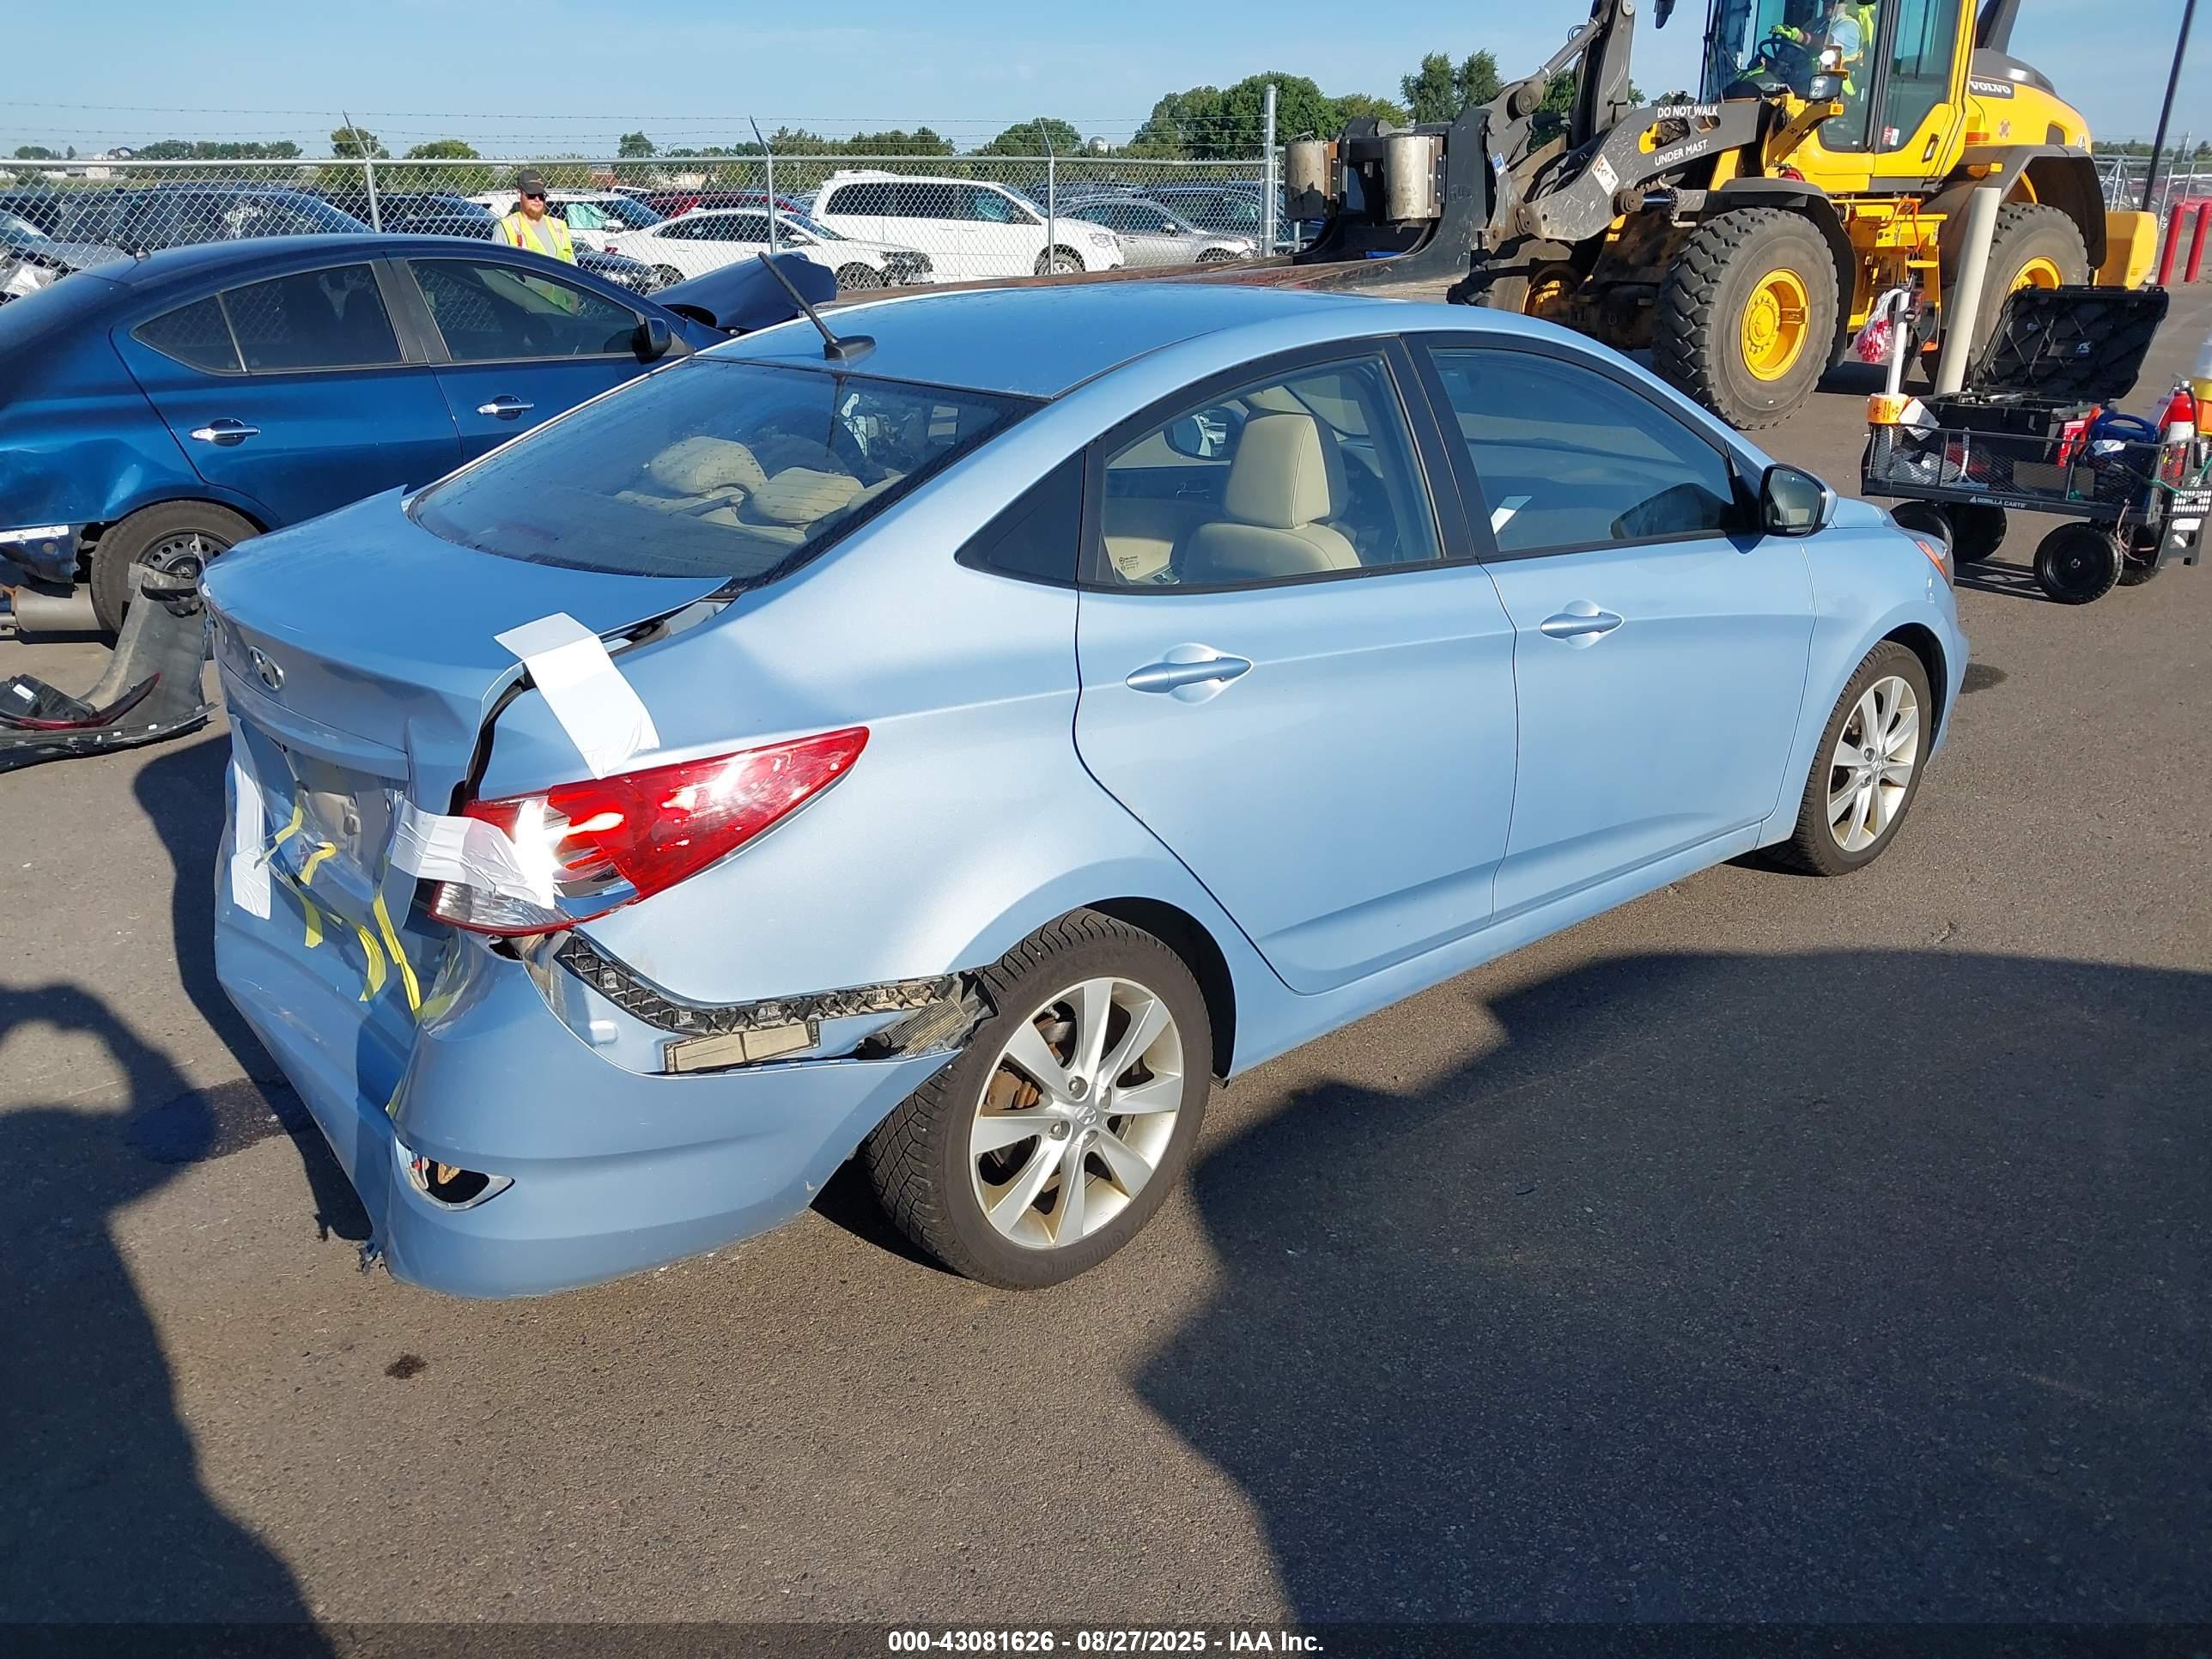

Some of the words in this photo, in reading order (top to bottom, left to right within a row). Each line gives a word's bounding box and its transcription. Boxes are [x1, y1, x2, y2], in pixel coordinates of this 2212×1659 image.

[1970, 81, 2011, 94] VOLVO
[1657, 107, 1671, 118] DO
[1673, 106, 1692, 117] NOT
[1693, 105, 1718, 116] WALK
[1655, 148, 1684, 166] UNDER
[1686, 139, 1708, 156] MAST
